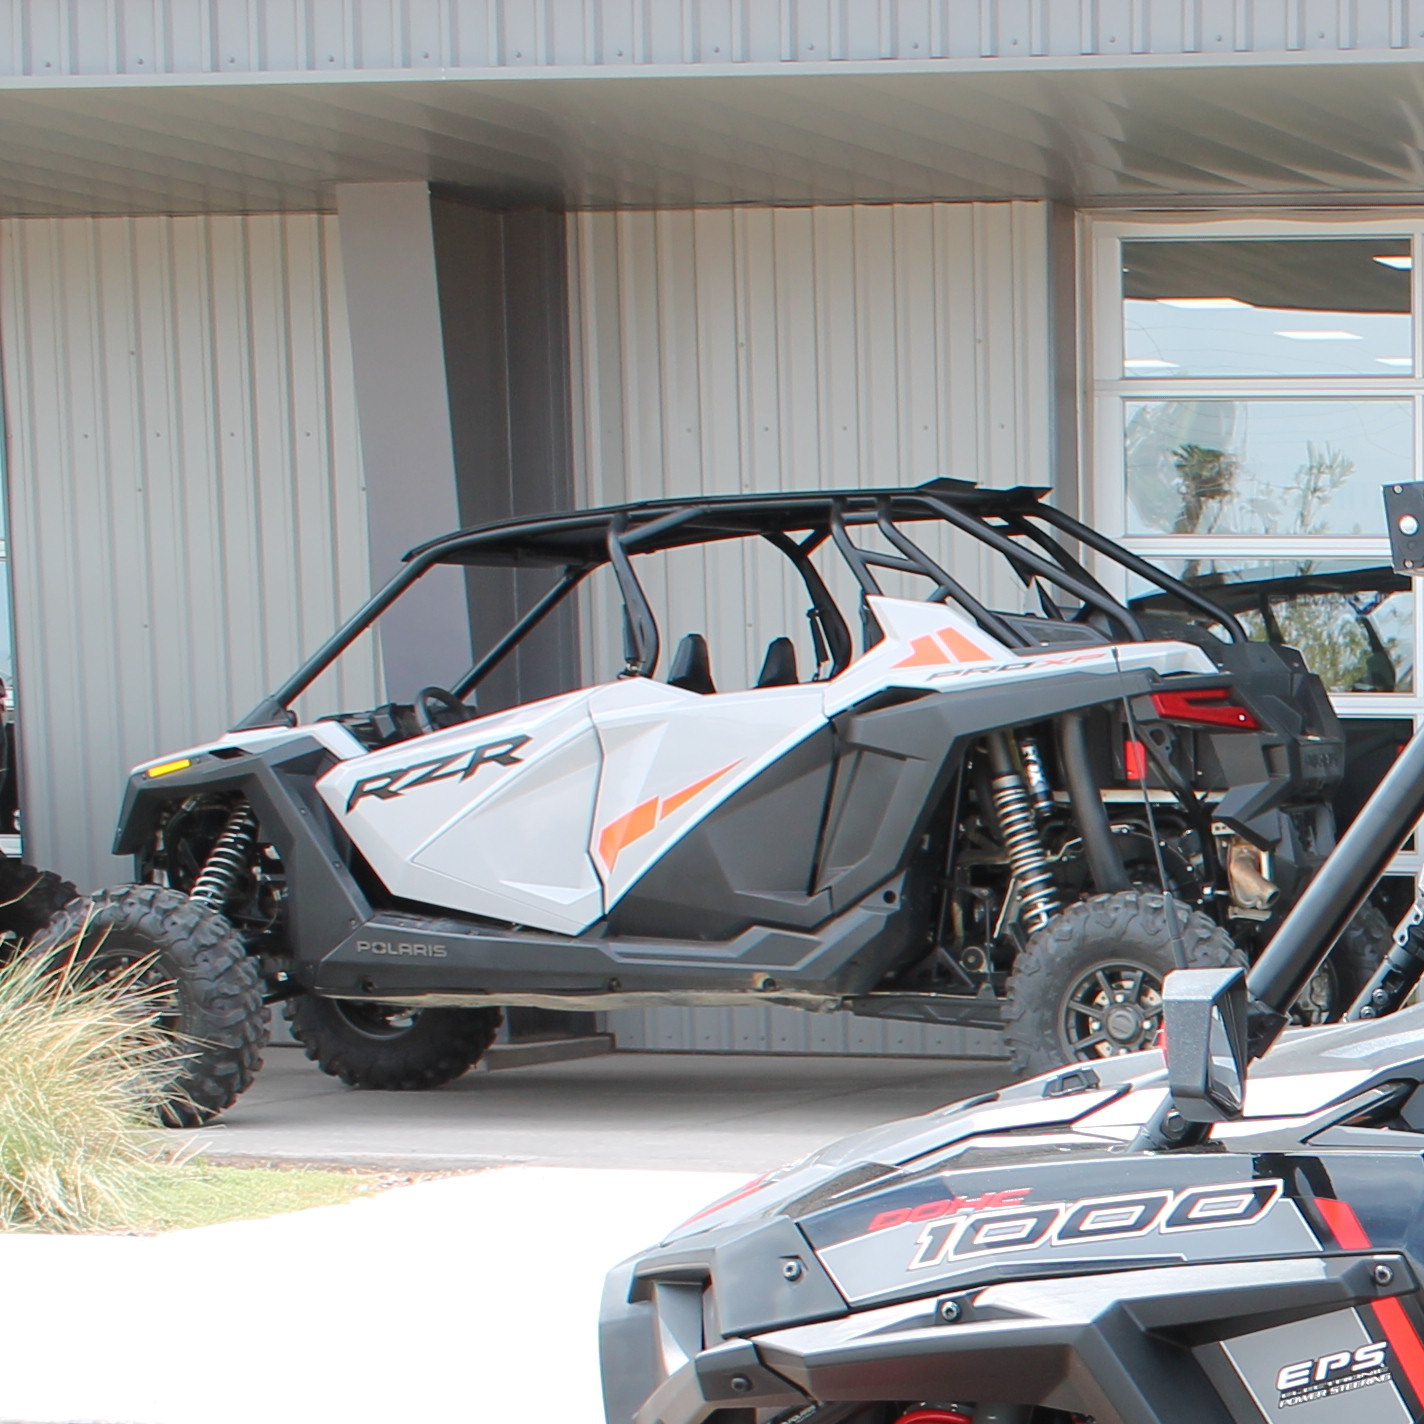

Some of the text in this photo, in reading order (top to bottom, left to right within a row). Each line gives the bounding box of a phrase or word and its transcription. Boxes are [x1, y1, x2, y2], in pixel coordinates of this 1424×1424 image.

[344, 734, 534, 816] RZR
[356, 940, 448, 958] POLARIS
[867, 1187, 1034, 1231] DOHC
[907, 1178, 1284, 1271] 1000
[1276, 1341, 1389, 1391] EPS
[1279, 1372, 1392, 1409] POWER STEERING
